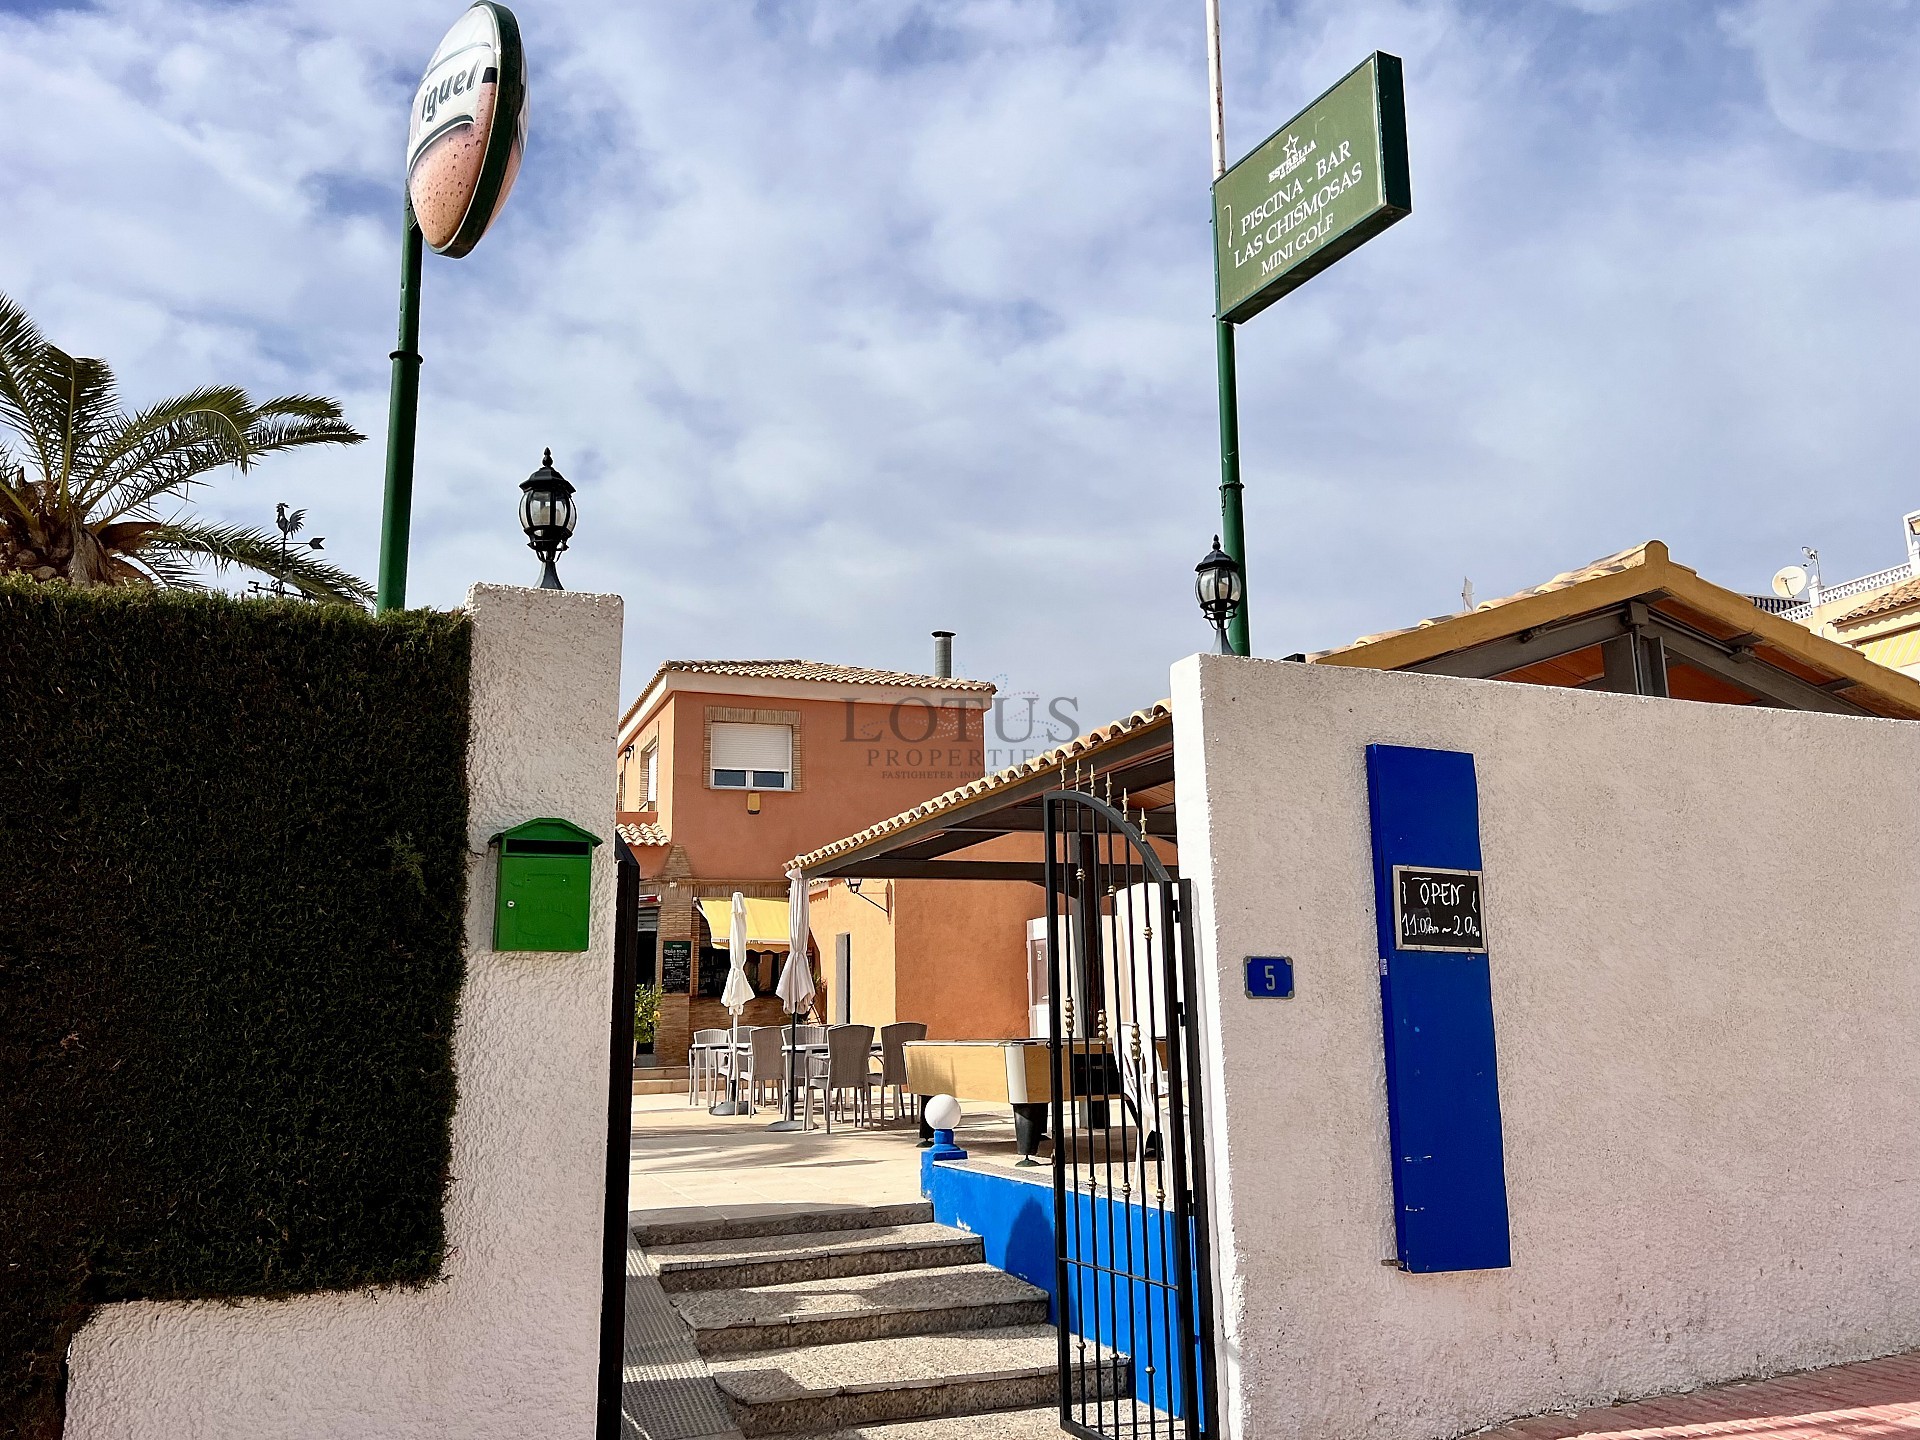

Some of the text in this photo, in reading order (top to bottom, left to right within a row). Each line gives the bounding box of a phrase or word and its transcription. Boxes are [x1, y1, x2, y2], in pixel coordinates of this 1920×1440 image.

[1240, 178, 1304, 236] PISCINA
[1316, 140, 1351, 180] BAR
[1268, 140, 1317, 184] ESTRELLA
[1234, 236, 1264, 268] LAS
[1265, 162, 1363, 244] CHISMOSAS
[1261, 213, 1335, 277] MINI GOLF
[1419, 882, 1466, 906] OPEN
[1264, 965, 1276, 991] 5
